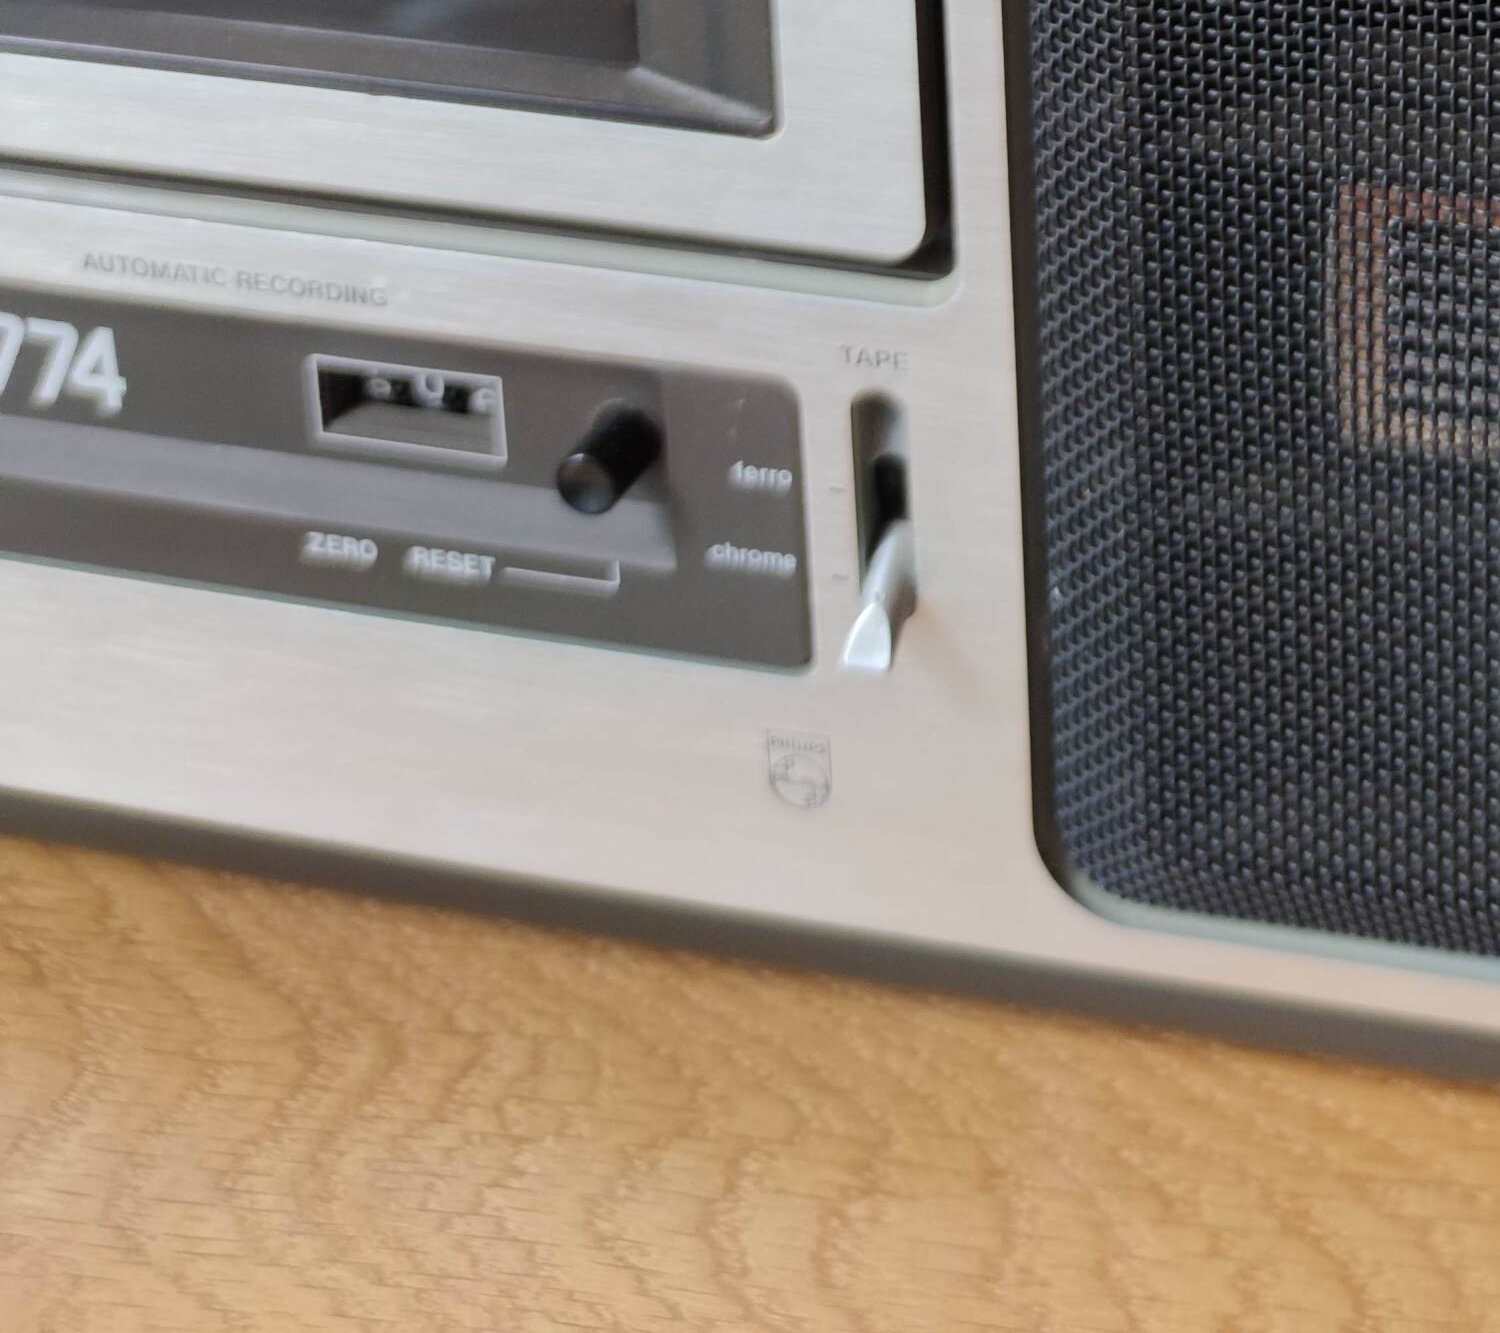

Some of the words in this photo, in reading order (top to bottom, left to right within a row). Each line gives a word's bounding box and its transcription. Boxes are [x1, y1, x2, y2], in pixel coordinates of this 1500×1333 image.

[81, 251, 228, 288] AUTOMATIC
[236, 270, 389, 308] RECORDING
[841, 343, 910, 372] TAPE
[730, 459, 793, 491] ferro
[302, 531, 379, 569] ZERO
[404, 545, 496, 583] RESET
[706, 541, 797, 578] chrome
